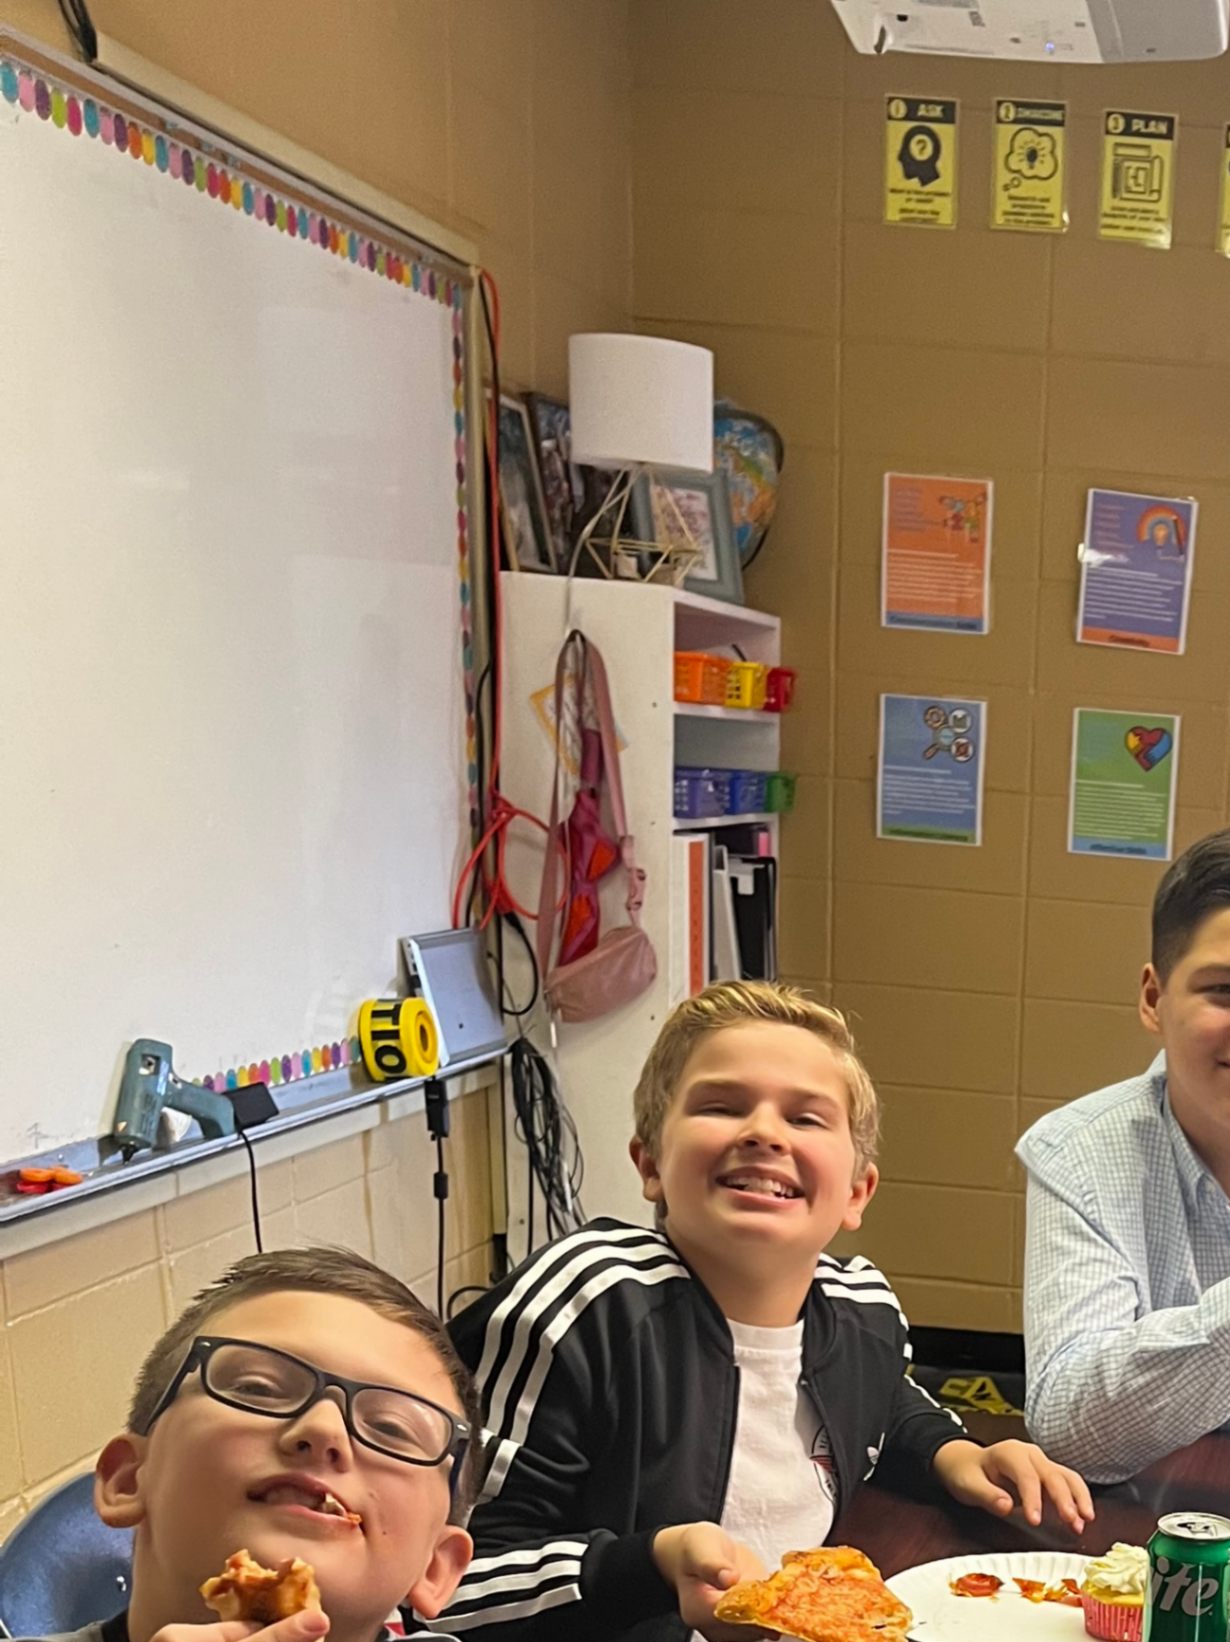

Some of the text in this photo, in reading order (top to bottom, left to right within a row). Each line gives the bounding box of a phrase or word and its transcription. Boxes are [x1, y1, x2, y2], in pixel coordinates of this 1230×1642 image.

[917, 103, 944, 118] ASK
[1131, 119, 1168, 135] PLAN
[370, 1002, 407, 1075] TIO
[1149, 1556, 1219, 1617] ite
